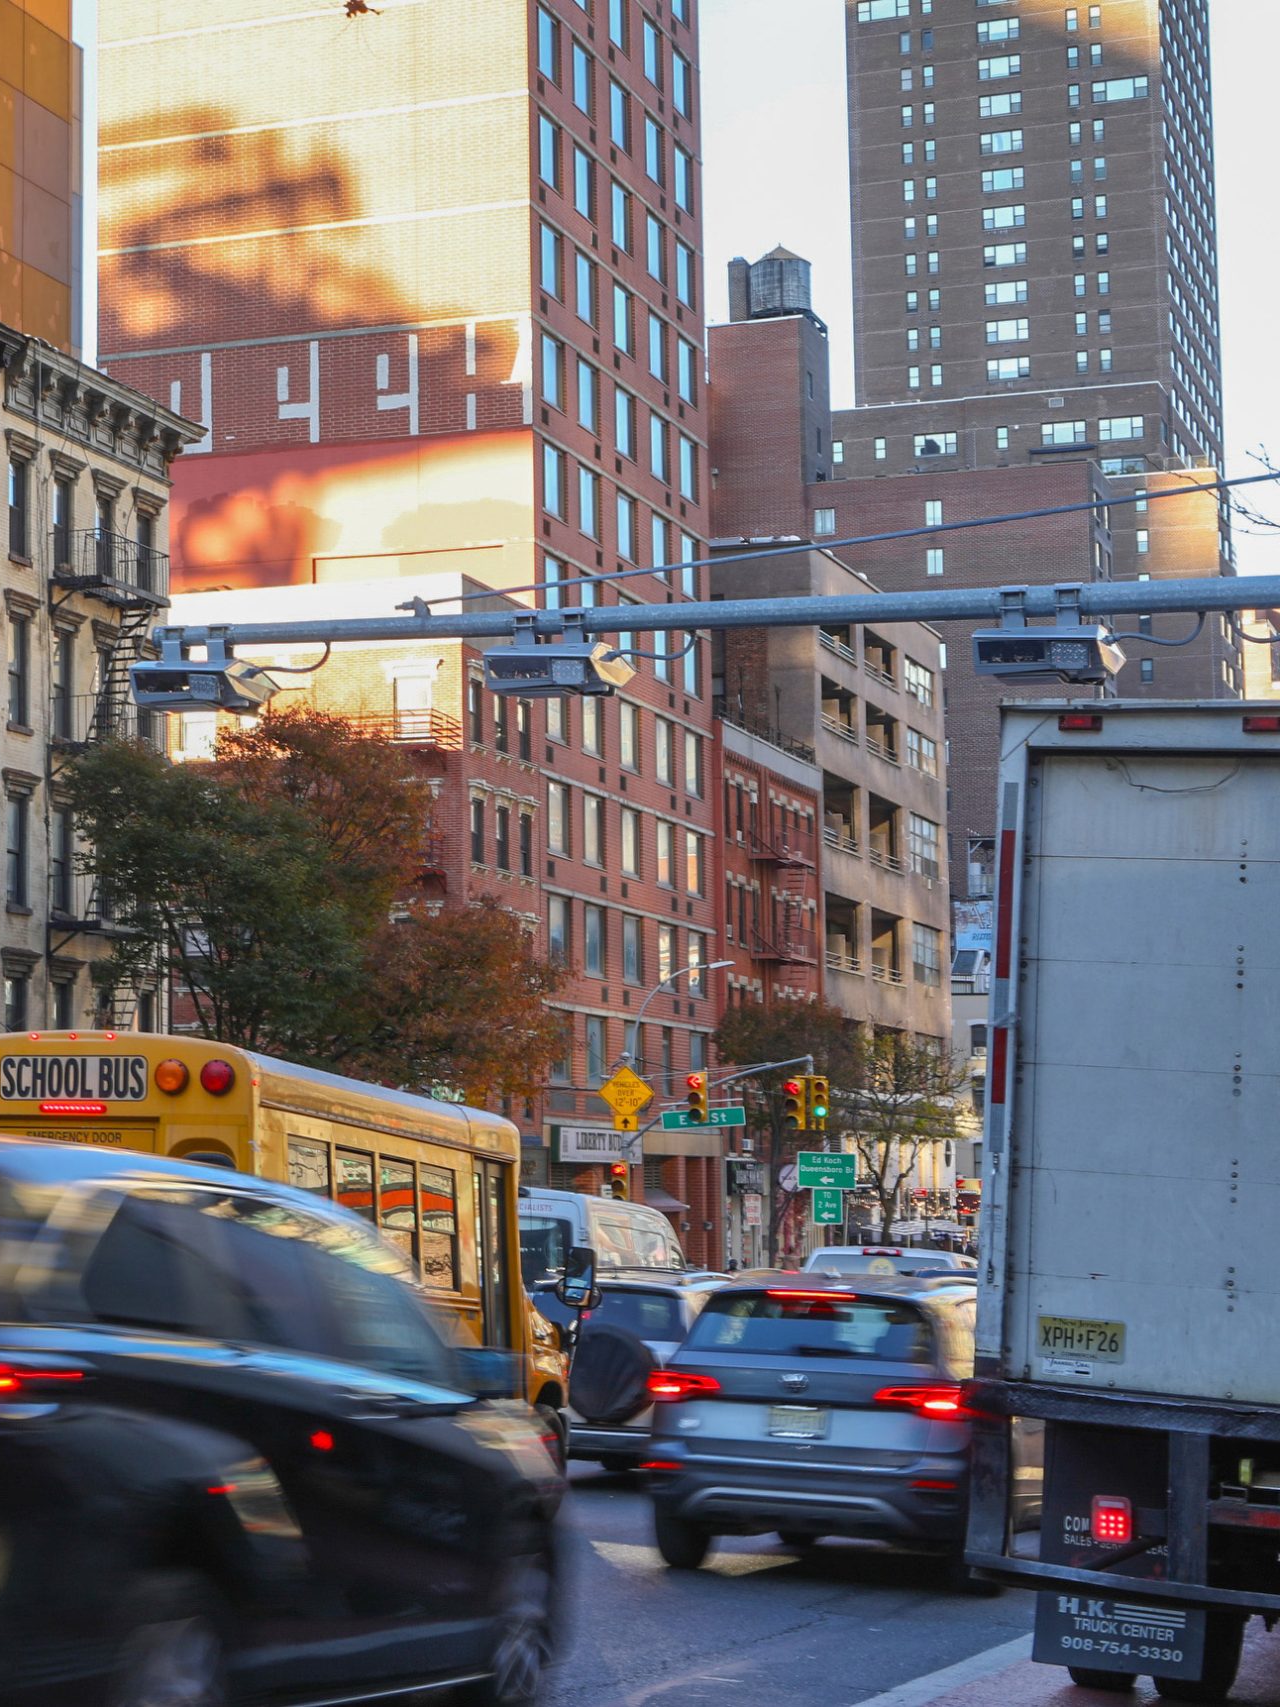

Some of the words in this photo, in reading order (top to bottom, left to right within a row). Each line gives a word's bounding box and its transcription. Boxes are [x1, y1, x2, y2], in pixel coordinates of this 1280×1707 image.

[1, 1058, 93, 1098] SCHOOL
[98, 1058, 145, 1099] BUS
[680, 1114, 688, 1125] E
[711, 1112, 727, 1123] St
[92, 1131, 121, 1143] DOOR
[575, 1131, 607, 1151] LIBERTY
[812, 1156, 821, 1164] Ed
[800, 1165, 842, 1173] Queensboro
[520, 1202, 552, 1211] CIALISTS
[1064, 1515, 1090, 1532] COM
[1063, 1533, 1092, 1547] SALES
[1057, 1596, 1113, 1620] H.K.
[1074, 1617, 1117, 1635] TRUCK
[1121, 1623, 1175, 1642] CENTER
[1060, 1635, 1184, 1663] 908-754-3330
